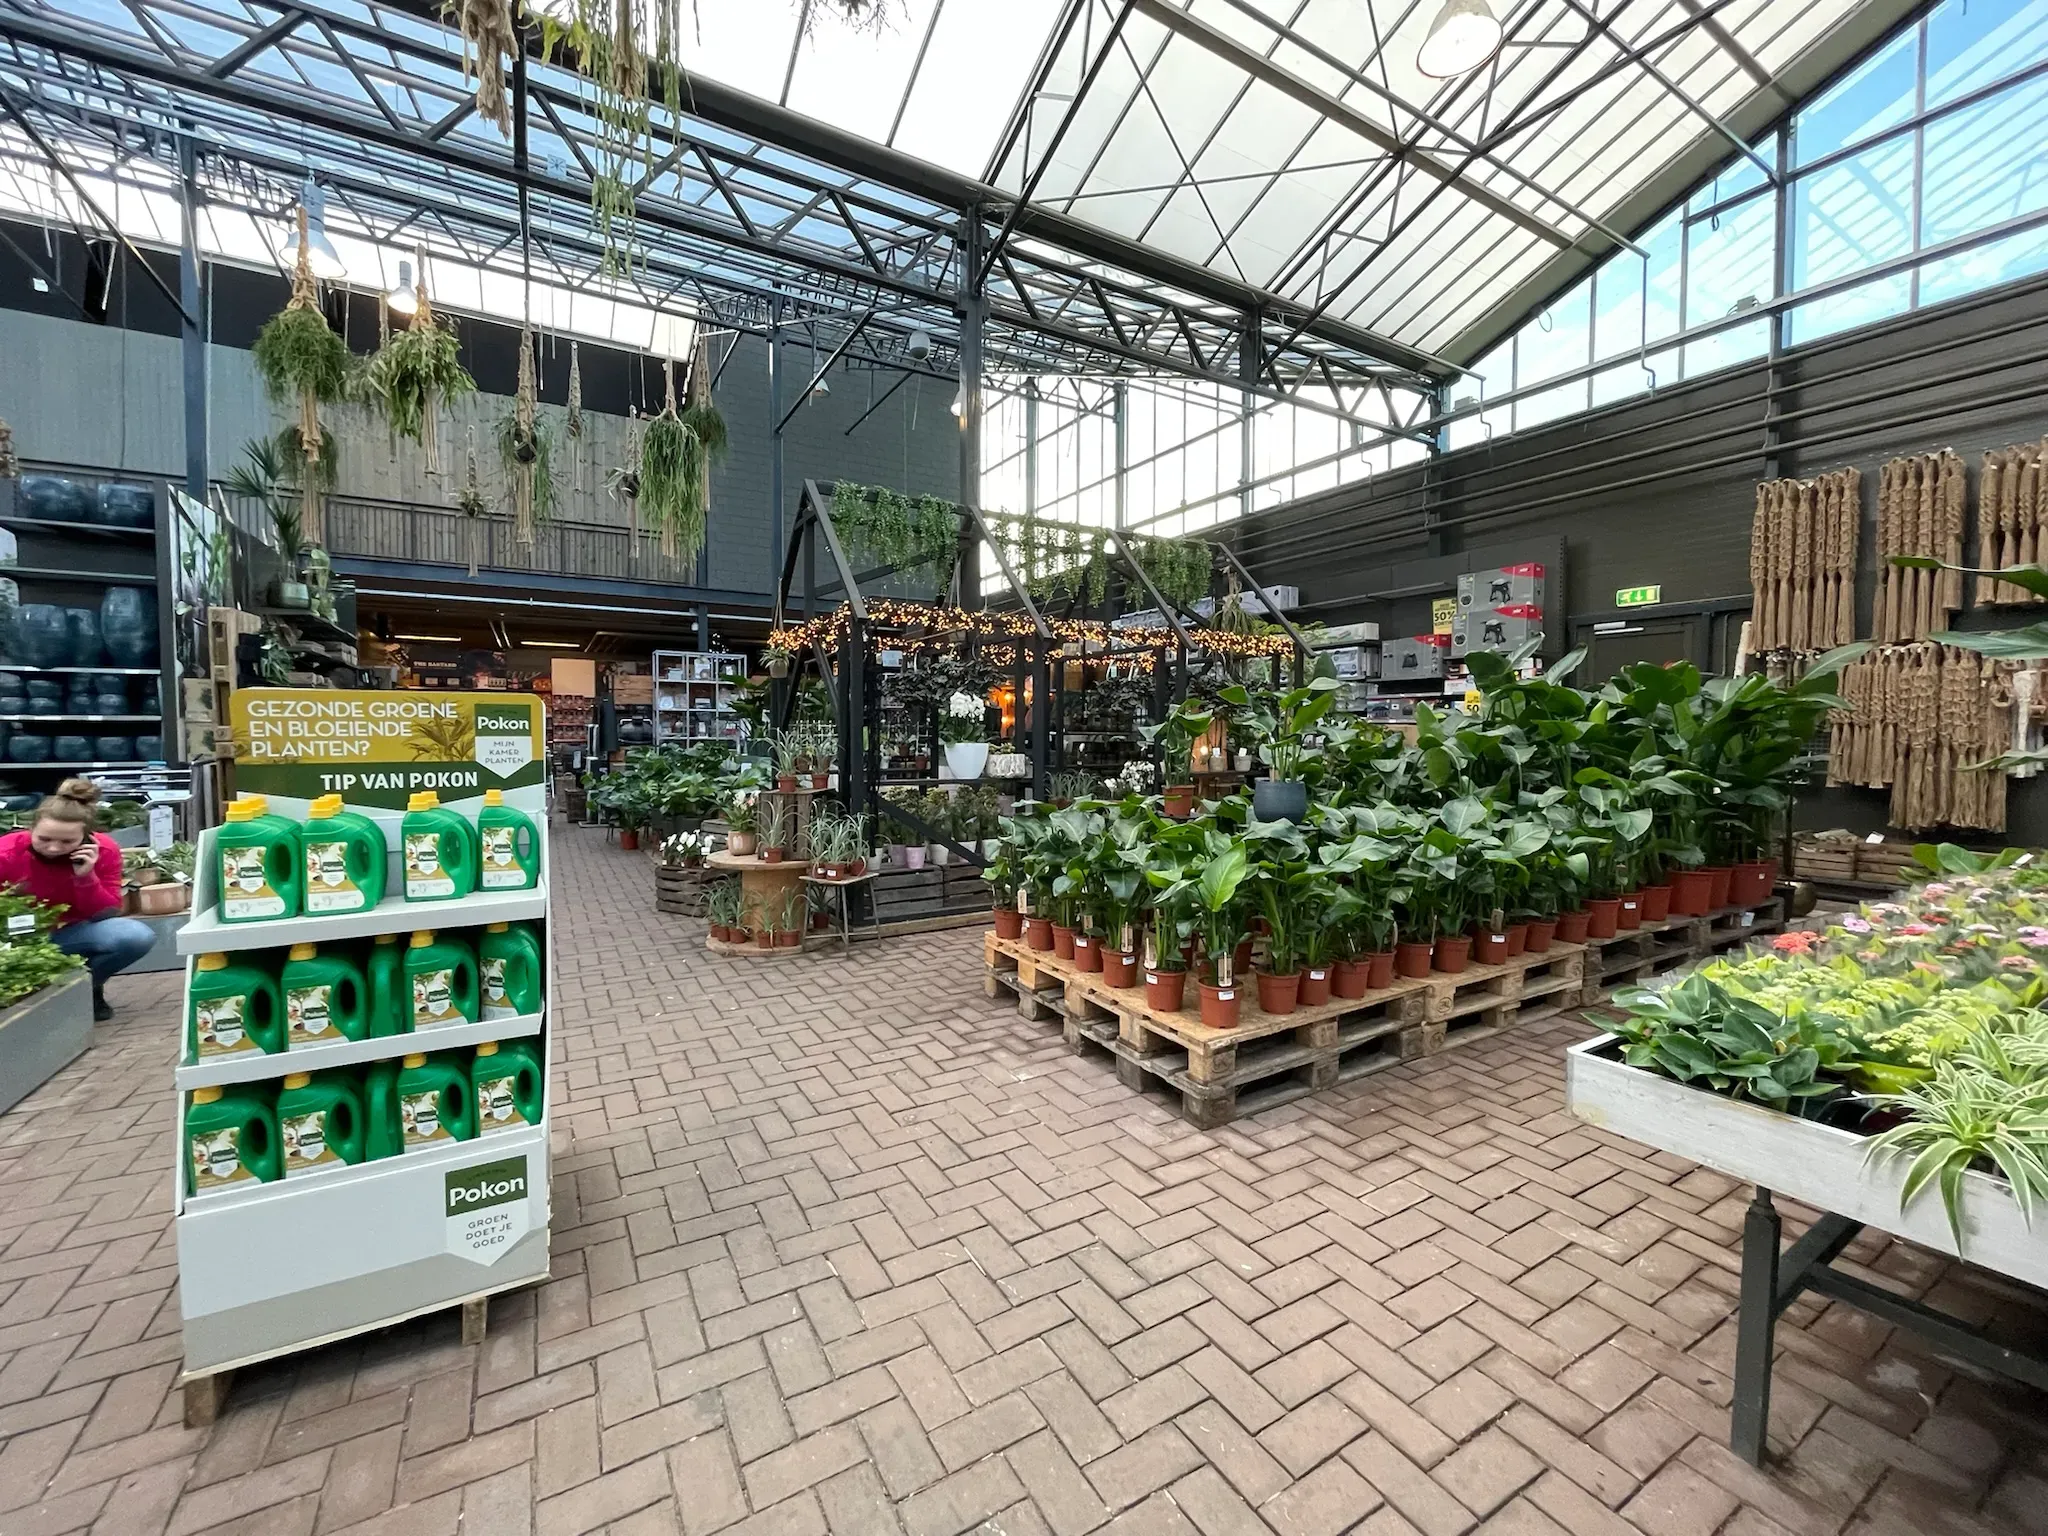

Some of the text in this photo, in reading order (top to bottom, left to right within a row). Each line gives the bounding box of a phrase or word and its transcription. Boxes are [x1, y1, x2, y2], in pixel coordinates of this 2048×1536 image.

[247, 700, 458, 718] GEZONDE GROENE
[249, 721, 413, 737] EN BLOEIENDE
[477, 716, 529, 730] Pokon
[251, 741, 371, 757] PLANTEN?
[320, 771, 478, 790] TIP VAN POKON
[449, 1177, 524, 1206] Pokon
[468, 1213, 508, 1229] GROEN
[466, 1223, 512, 1240] DOET JE
[472, 1236, 504, 1248] GOED
